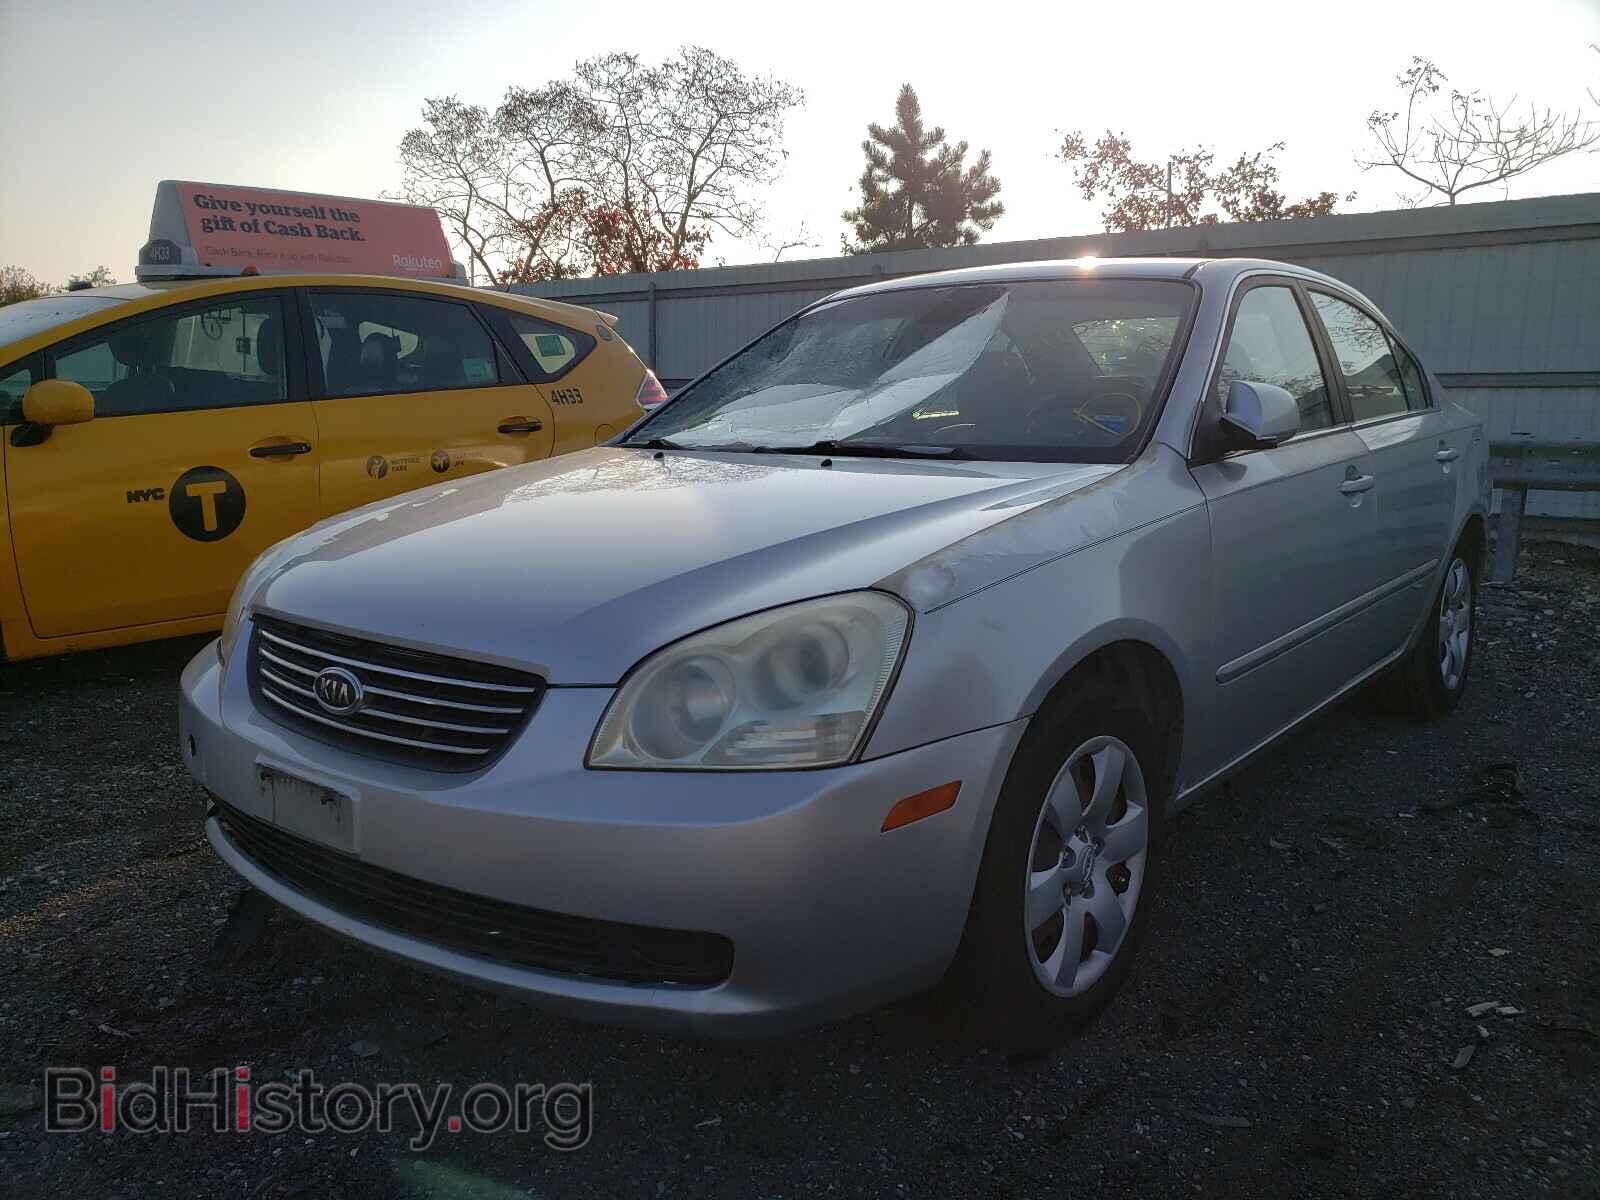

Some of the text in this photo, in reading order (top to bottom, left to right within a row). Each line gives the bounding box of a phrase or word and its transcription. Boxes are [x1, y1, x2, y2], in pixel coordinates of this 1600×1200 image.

[193, 194, 361, 222] Give yourself the
[201, 215, 366, 241] gift of Cash Back.
[392, 254, 443, 270] Rakuten
[551, 388, 584, 405] 4H33
[126, 487, 165, 504] NYC
[185, 480, 227, 532] T
[320, 676, 350, 705] KIA
